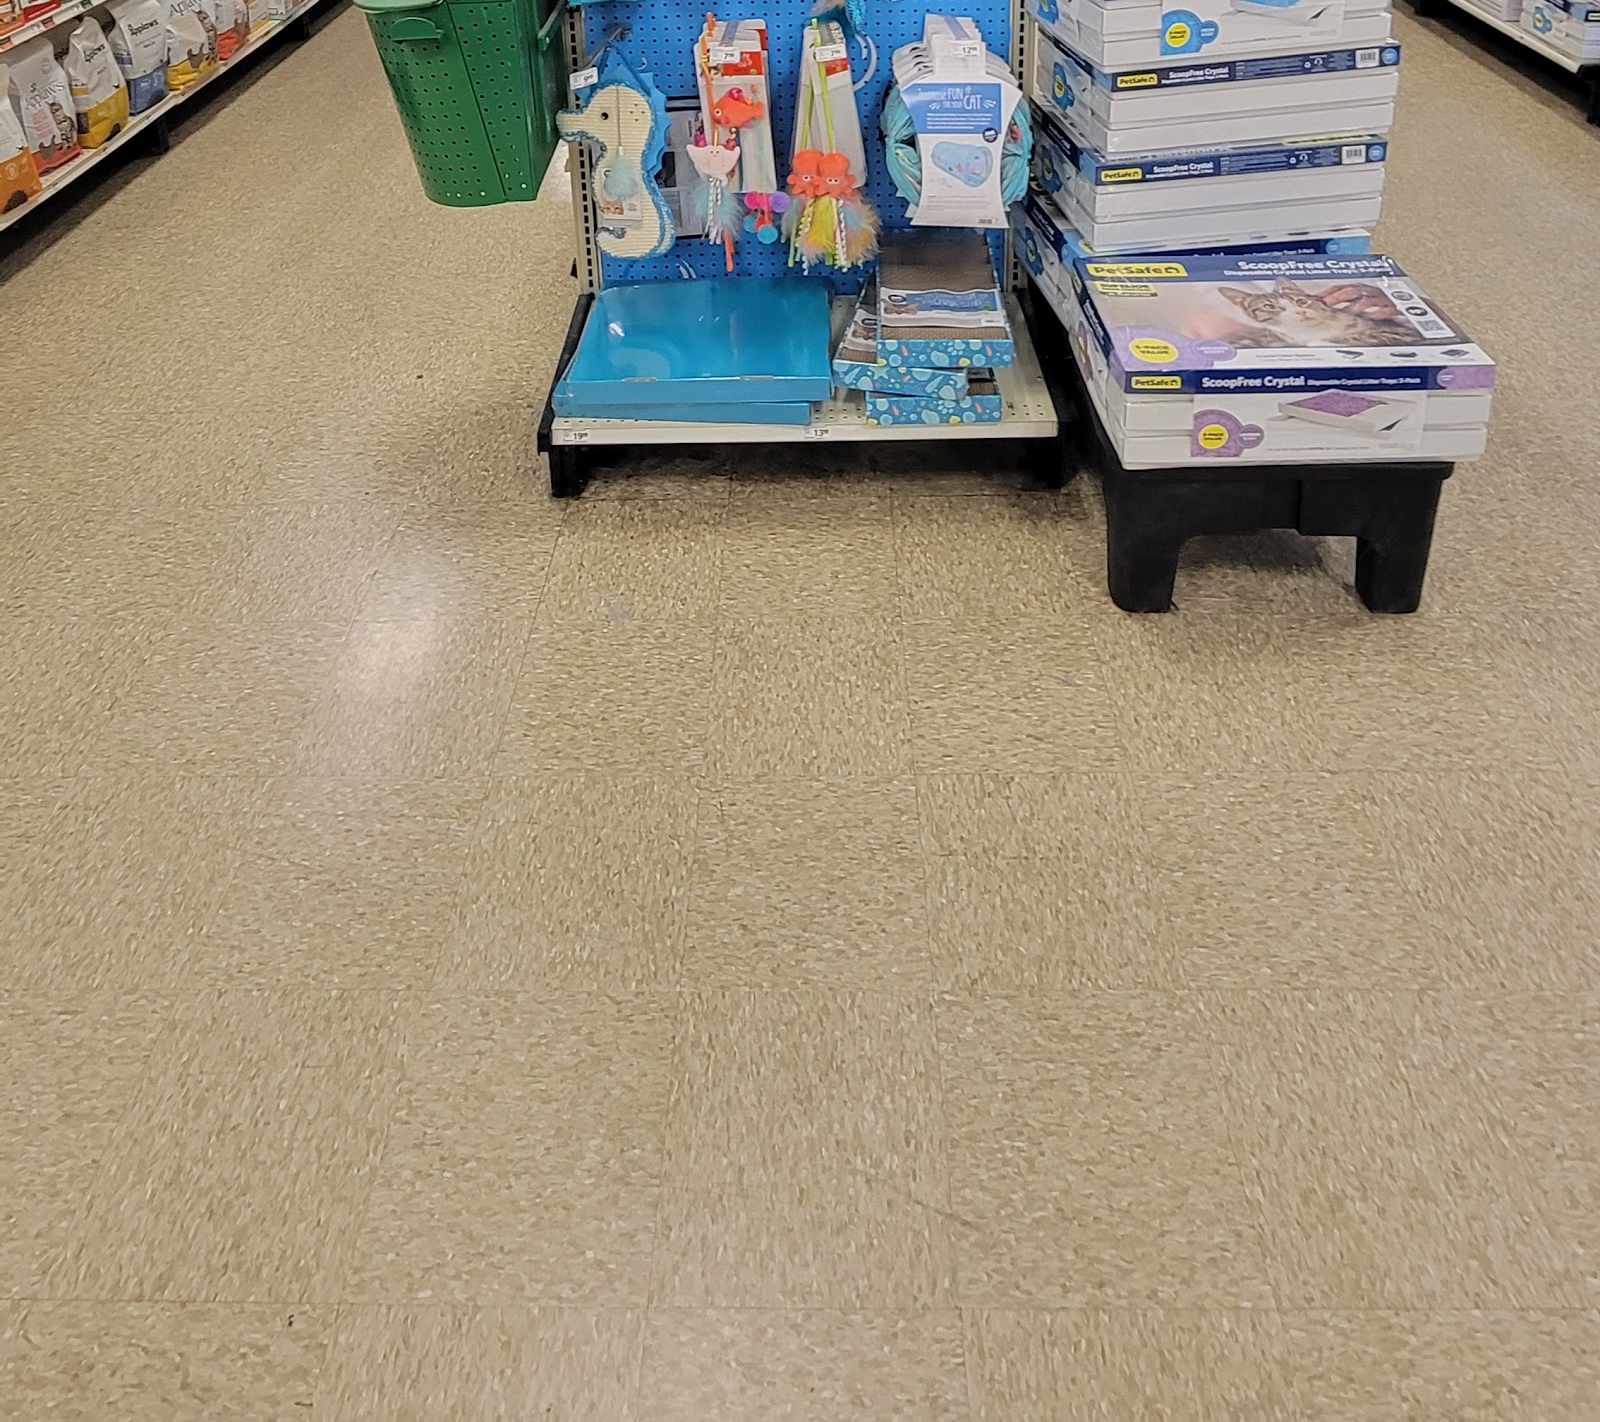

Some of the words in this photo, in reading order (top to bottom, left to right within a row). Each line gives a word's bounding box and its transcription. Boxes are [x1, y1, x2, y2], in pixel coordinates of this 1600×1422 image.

[1119, 77, 1148, 86] PetSafe
[1204, 66, 1230, 76] Crystal
[947, 87, 964, 100] FUN
[963, 94, 982, 110] CAT
[1103, 171, 1132, 180] PetSafe
[1189, 161, 1214, 171] Crystal
[1094, 266, 1162, 275] PetSafe
[1238, 261, 1323, 271] ScoopFree
[1326, 259, 1386, 269] Crystal
[1134, 379, 1170, 387] PetSafe
[1202, 377, 1262, 389] ScoopFree
[1264, 376, 1305, 389] Crystal
